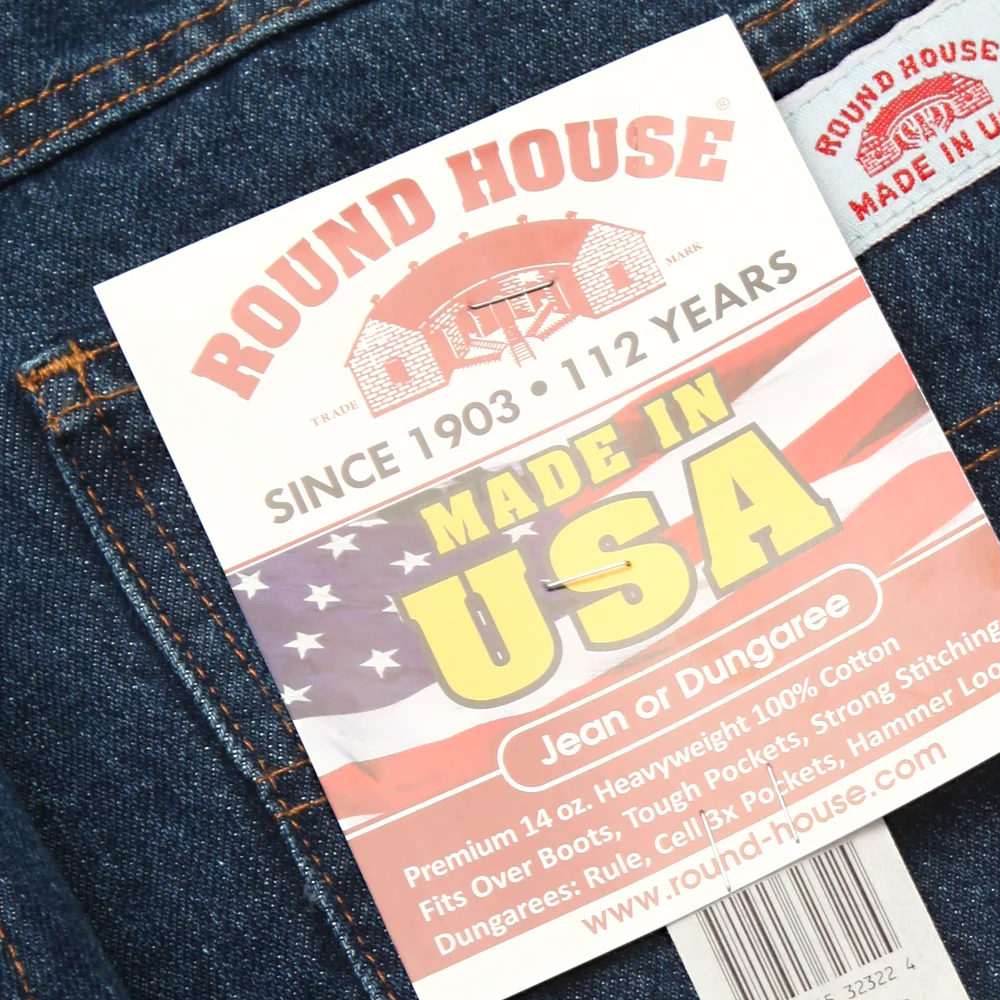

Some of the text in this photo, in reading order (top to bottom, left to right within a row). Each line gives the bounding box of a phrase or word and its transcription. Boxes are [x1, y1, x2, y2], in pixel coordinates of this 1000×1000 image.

[814, 39, 1000, 156] ROUND HOUSE
[847, 154, 936, 221] MADE
[940, 130, 975, 164] IN
[191, 178, 436, 400] ROUND
[445, 115, 735, 212] HOUSE
[664, 241, 704, 266] MARK
[265, 249, 798, 524] SINCE 1903 112 YEARS
[310, 401, 359, 427] TRADE
[418, 370, 733, 554] MADE IN
[402, 424, 841, 707] USA
[403, 636, 900, 888] Premium 14 oz. Heavyweight 100% Cotton
[541, 594, 851, 765] Jean or Dungaree
[418, 890, 468, 922] Fits
[471, 859, 532, 897] Over
[537, 823, 622, 869] Boots,
[622, 781, 702, 828] Tough
[704, 730, 809, 790] Pockets,
[810, 681, 895, 735] Strong
[434, 880, 580, 956] Dungarees:
[583, 850, 651, 888] Rule,
[654, 817, 700, 854] Cell
[709, 805, 740, 831] 3x
[740, 753, 845, 812] Pockets,
[846, 688, 953, 757] Hammer
[581, 742, 947, 935] www.round-house.com
[842, 966, 897, 1000] 32322
[906, 958, 916, 970] 4
